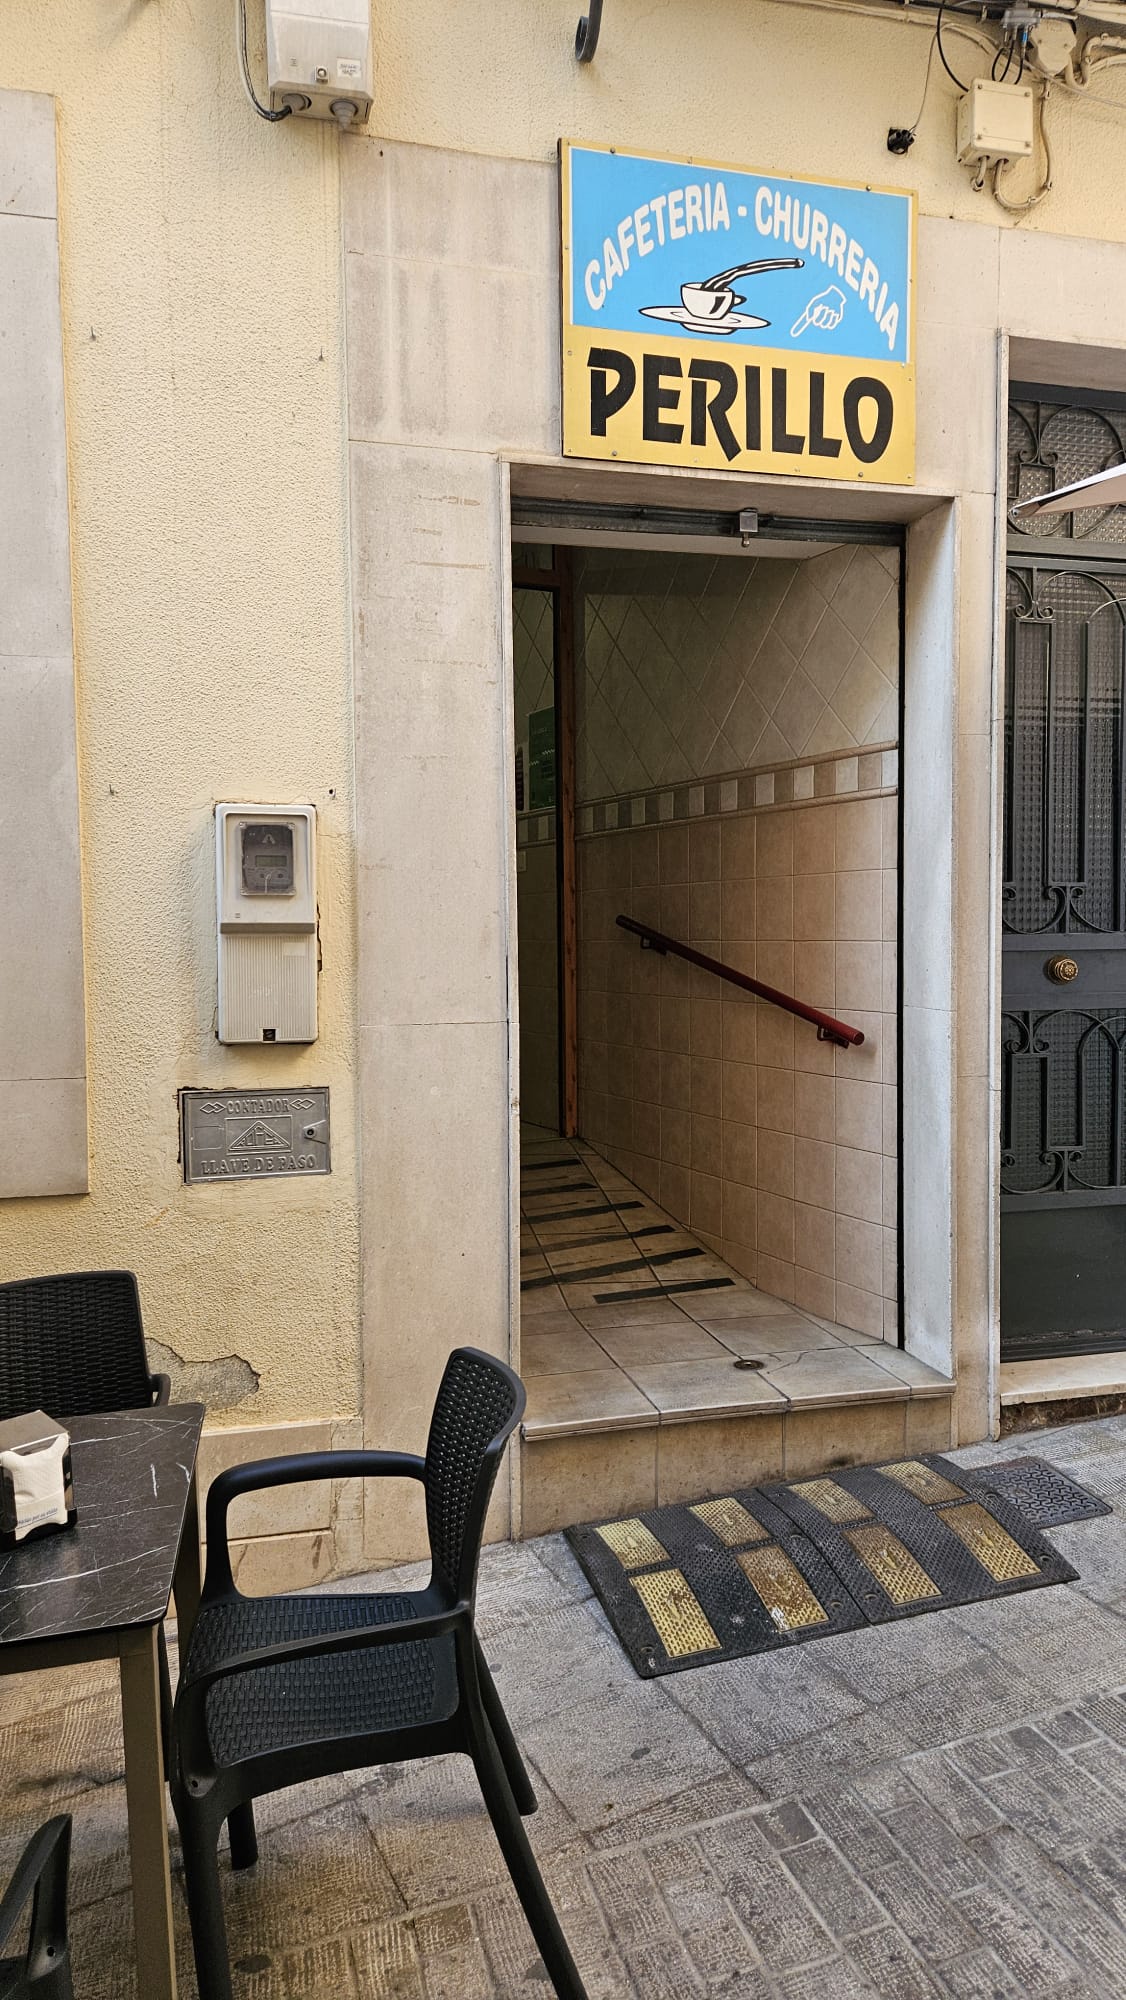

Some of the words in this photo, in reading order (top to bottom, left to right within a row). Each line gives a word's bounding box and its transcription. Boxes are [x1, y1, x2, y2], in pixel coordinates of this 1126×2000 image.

[584, 182, 730, 311] CAFETERIA
[755, 187, 900, 351] CHURRERIA
[587, 347, 894, 464] PERILLO
[226, 1099, 290, 1114] CONTADOR
[201, 1157, 249, 1175] LLAVE
[254, 1156, 274, 1171] DE
[278, 1154, 317, 1170] PASO
